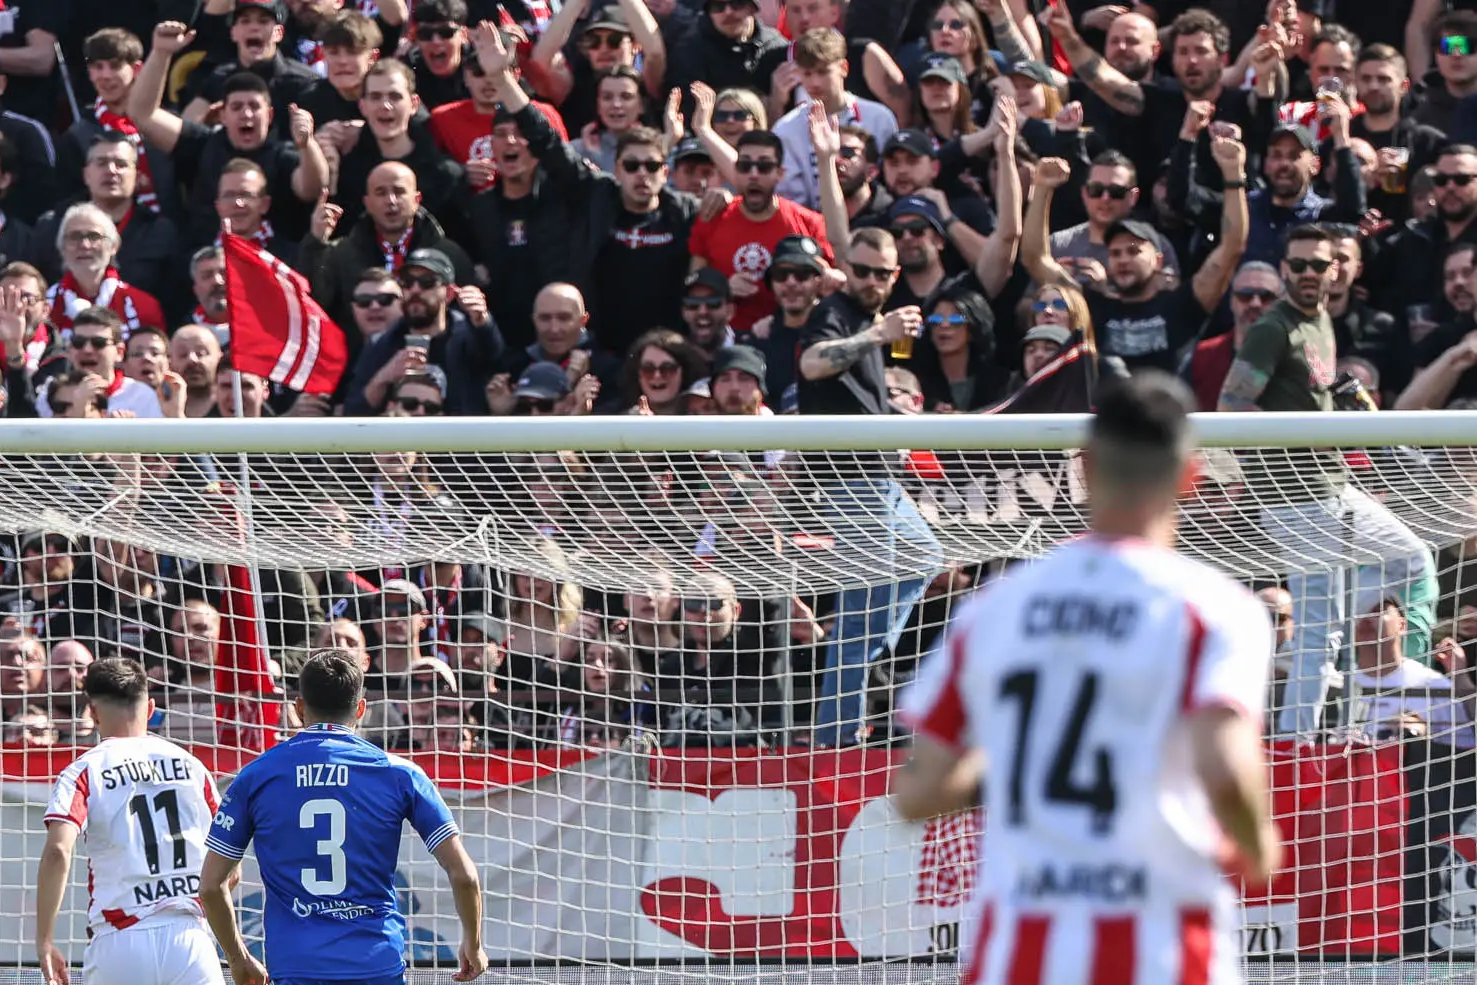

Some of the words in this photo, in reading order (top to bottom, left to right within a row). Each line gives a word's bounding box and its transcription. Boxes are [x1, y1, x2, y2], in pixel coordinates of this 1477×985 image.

[296, 764, 349, 788] RIZZO
[995, 665, 1116, 837] 14
[129, 789, 187, 875] 11
[299, 798, 346, 896] 3
